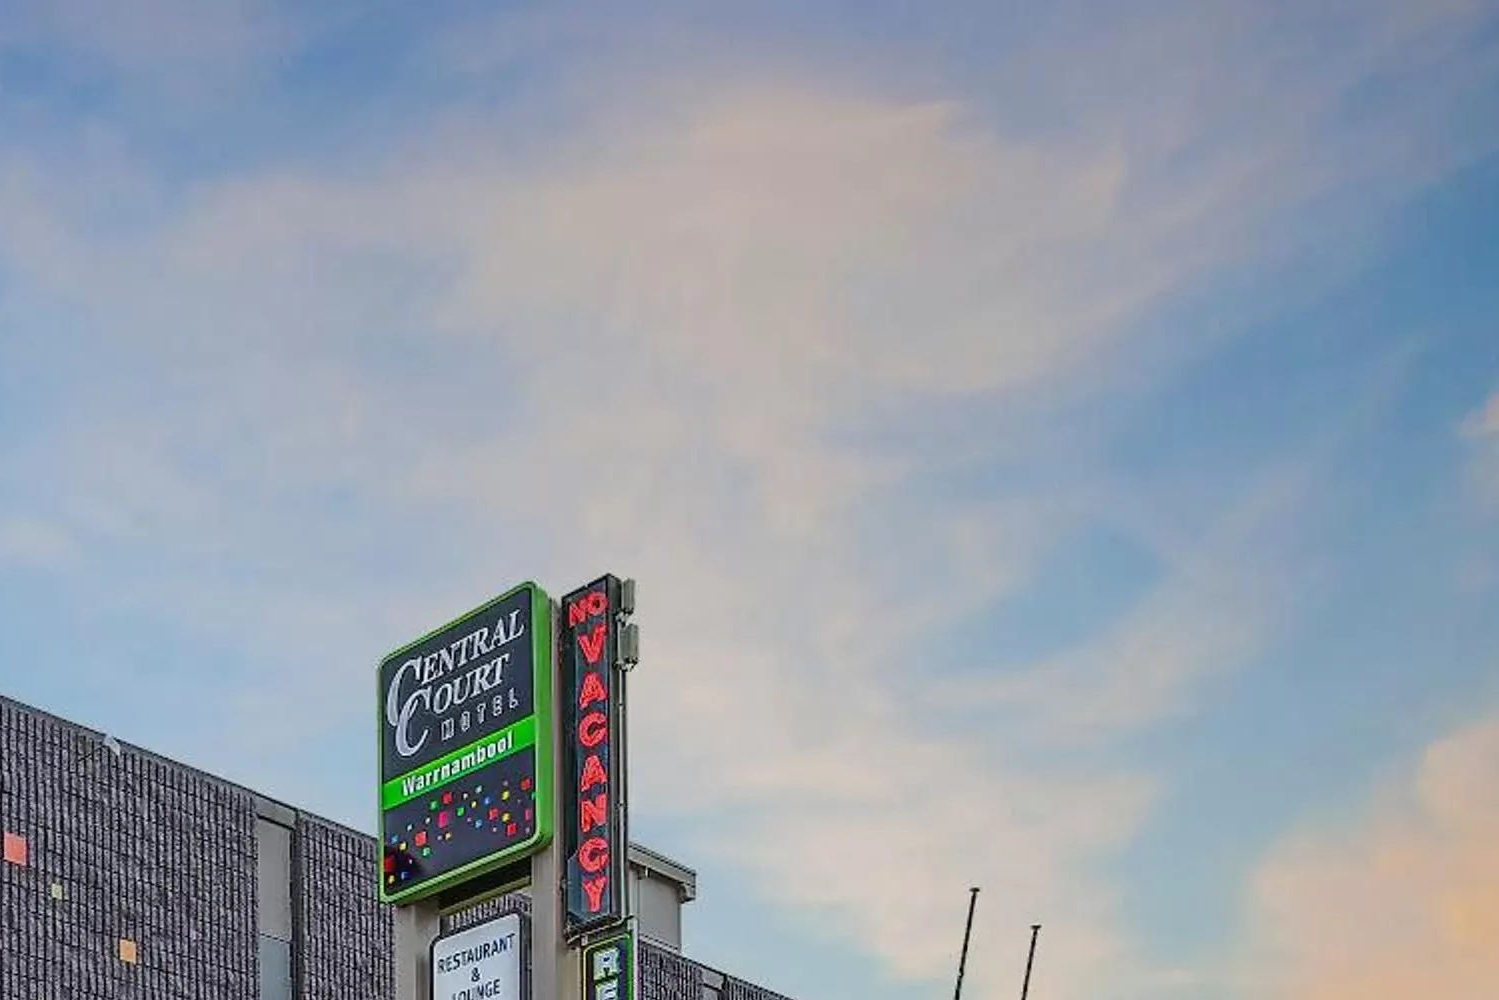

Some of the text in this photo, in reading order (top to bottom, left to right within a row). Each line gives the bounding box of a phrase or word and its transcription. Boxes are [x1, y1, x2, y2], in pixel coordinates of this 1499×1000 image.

[569, 591, 608, 627] NO
[402, 729, 514, 797] Warrnambool
[577, 622, 609, 912] VACANCY
[437, 932, 516, 975] RESTAURANT
[471, 966, 481, 982] &
